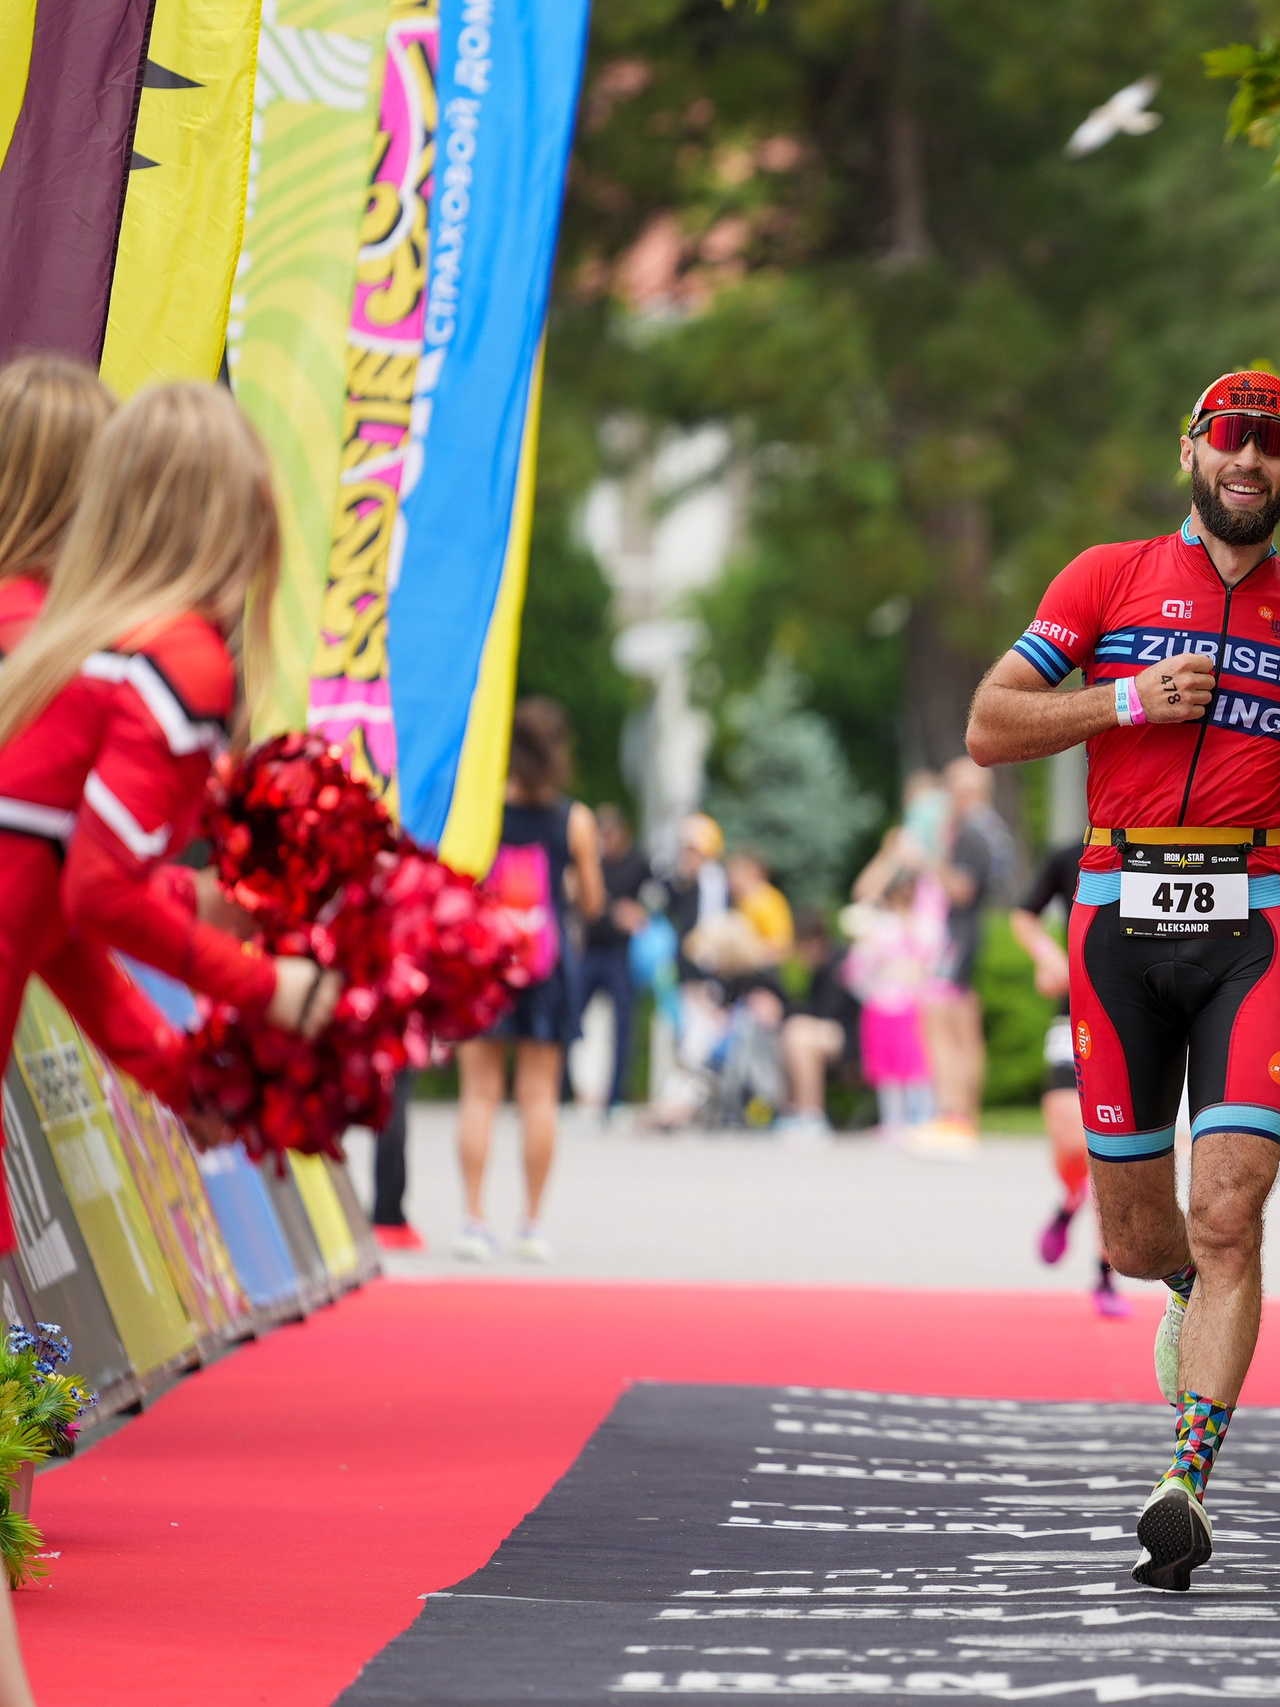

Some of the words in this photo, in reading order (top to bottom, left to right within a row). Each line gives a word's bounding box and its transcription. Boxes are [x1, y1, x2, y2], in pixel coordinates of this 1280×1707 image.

[424, 97, 482, 346] СТРАХОВОЙ
[1230, 393, 1278, 409] BIRRA
[1161, 675, 1181, 705] 478
[1163, 852, 1180, 862] IRON
[1187, 852, 1205, 862] STAR
[1152, 882, 1215, 913] 478
[1156, 922, 1209, 933] ALEKSANDR
[1078, 1027, 1087, 1054] KIDS
[727, 1516, 1026, 1532] IRON
[621, 1671, 1011, 1691] IRON
